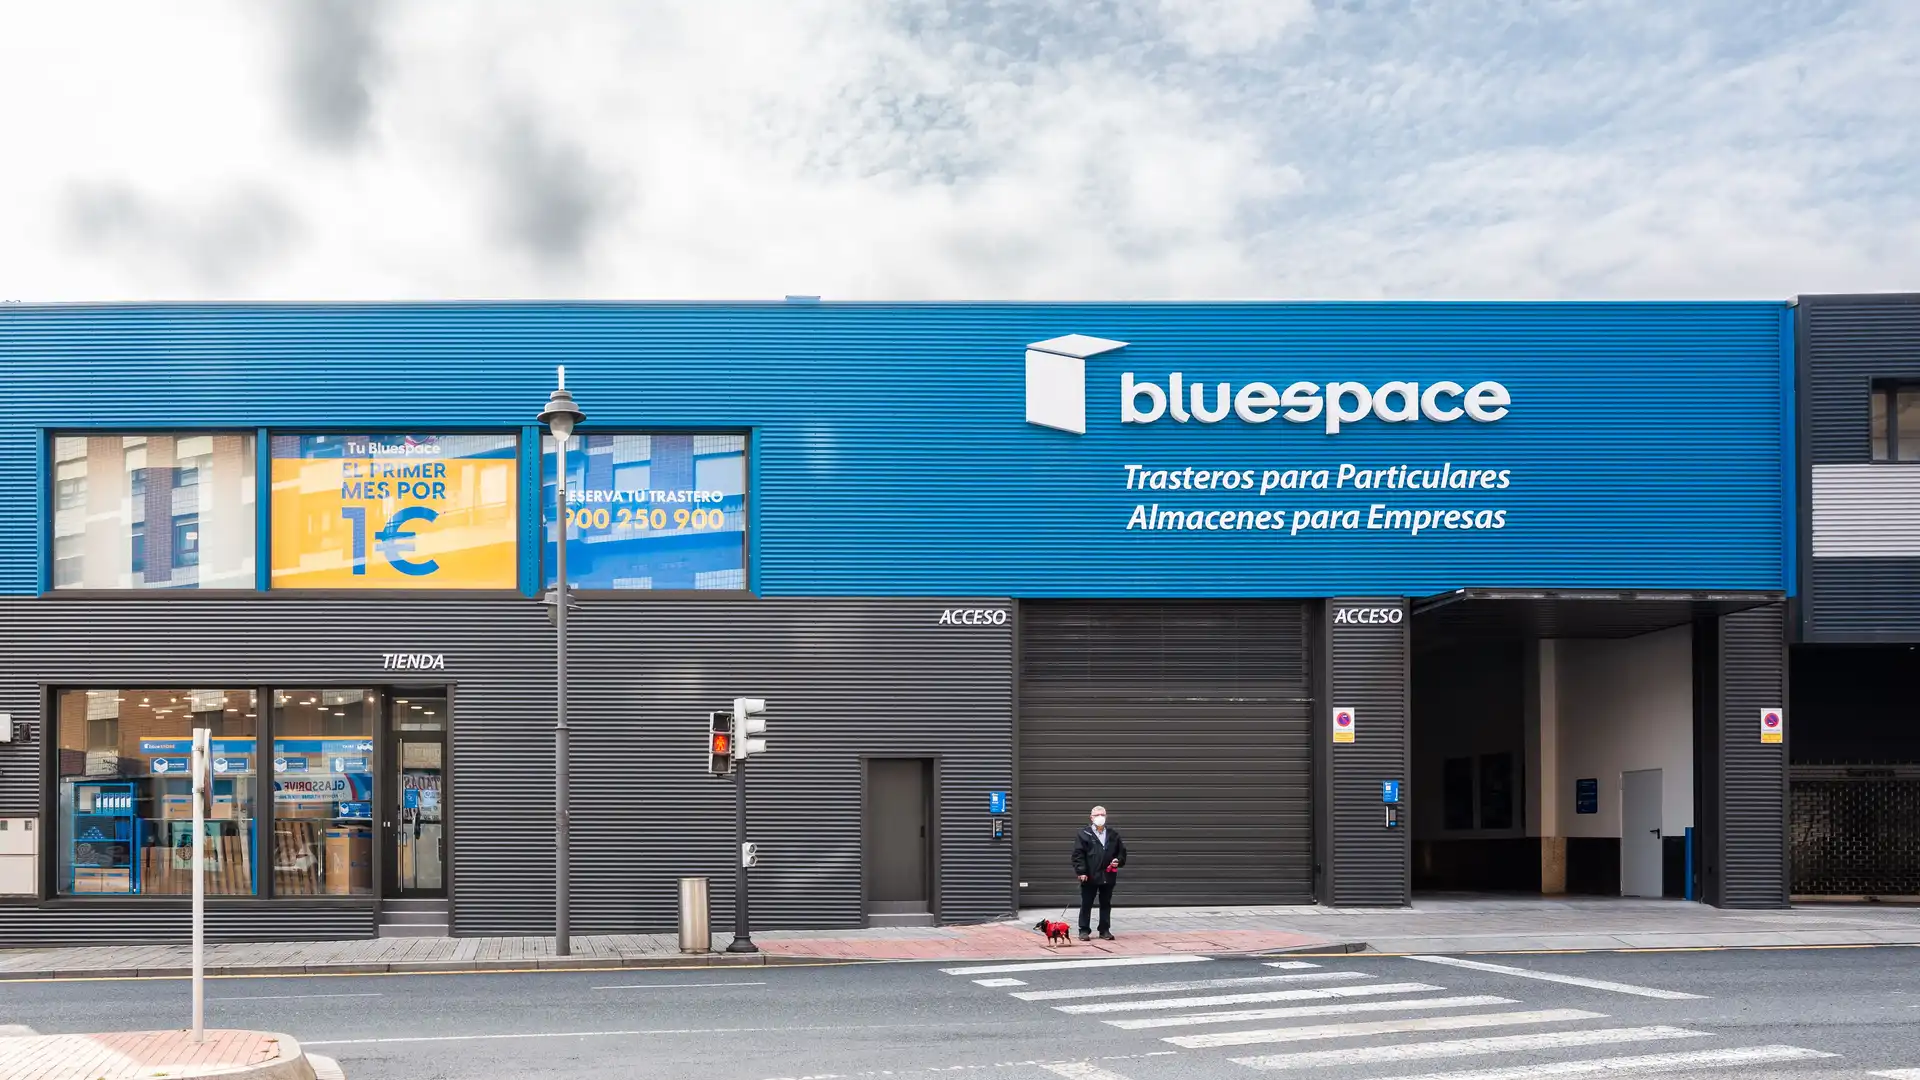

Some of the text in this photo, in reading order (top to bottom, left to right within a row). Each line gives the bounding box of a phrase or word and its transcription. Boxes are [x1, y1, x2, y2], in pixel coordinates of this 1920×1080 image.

[1121, 371, 1512, 435] bluespace
[348, 441, 441, 456] Tu Bluespace
[342, 462, 446, 478] EL PRIMER
[1124, 462, 1511, 496] Trasteros para Particulares
[341, 481, 446, 500] MES POR
[649, 490, 724, 503] TRASTERO
[616, 508, 667, 530] 250
[673, 508, 725, 530] 900
[1126, 503, 1507, 536] Almacenes para Empresas
[341, 506, 440, 576] 1€
[938, 609, 1007, 625] ACCESO
[1334, 608, 1403, 624] ACCESO
[382, 653, 445, 669] TIENDA
